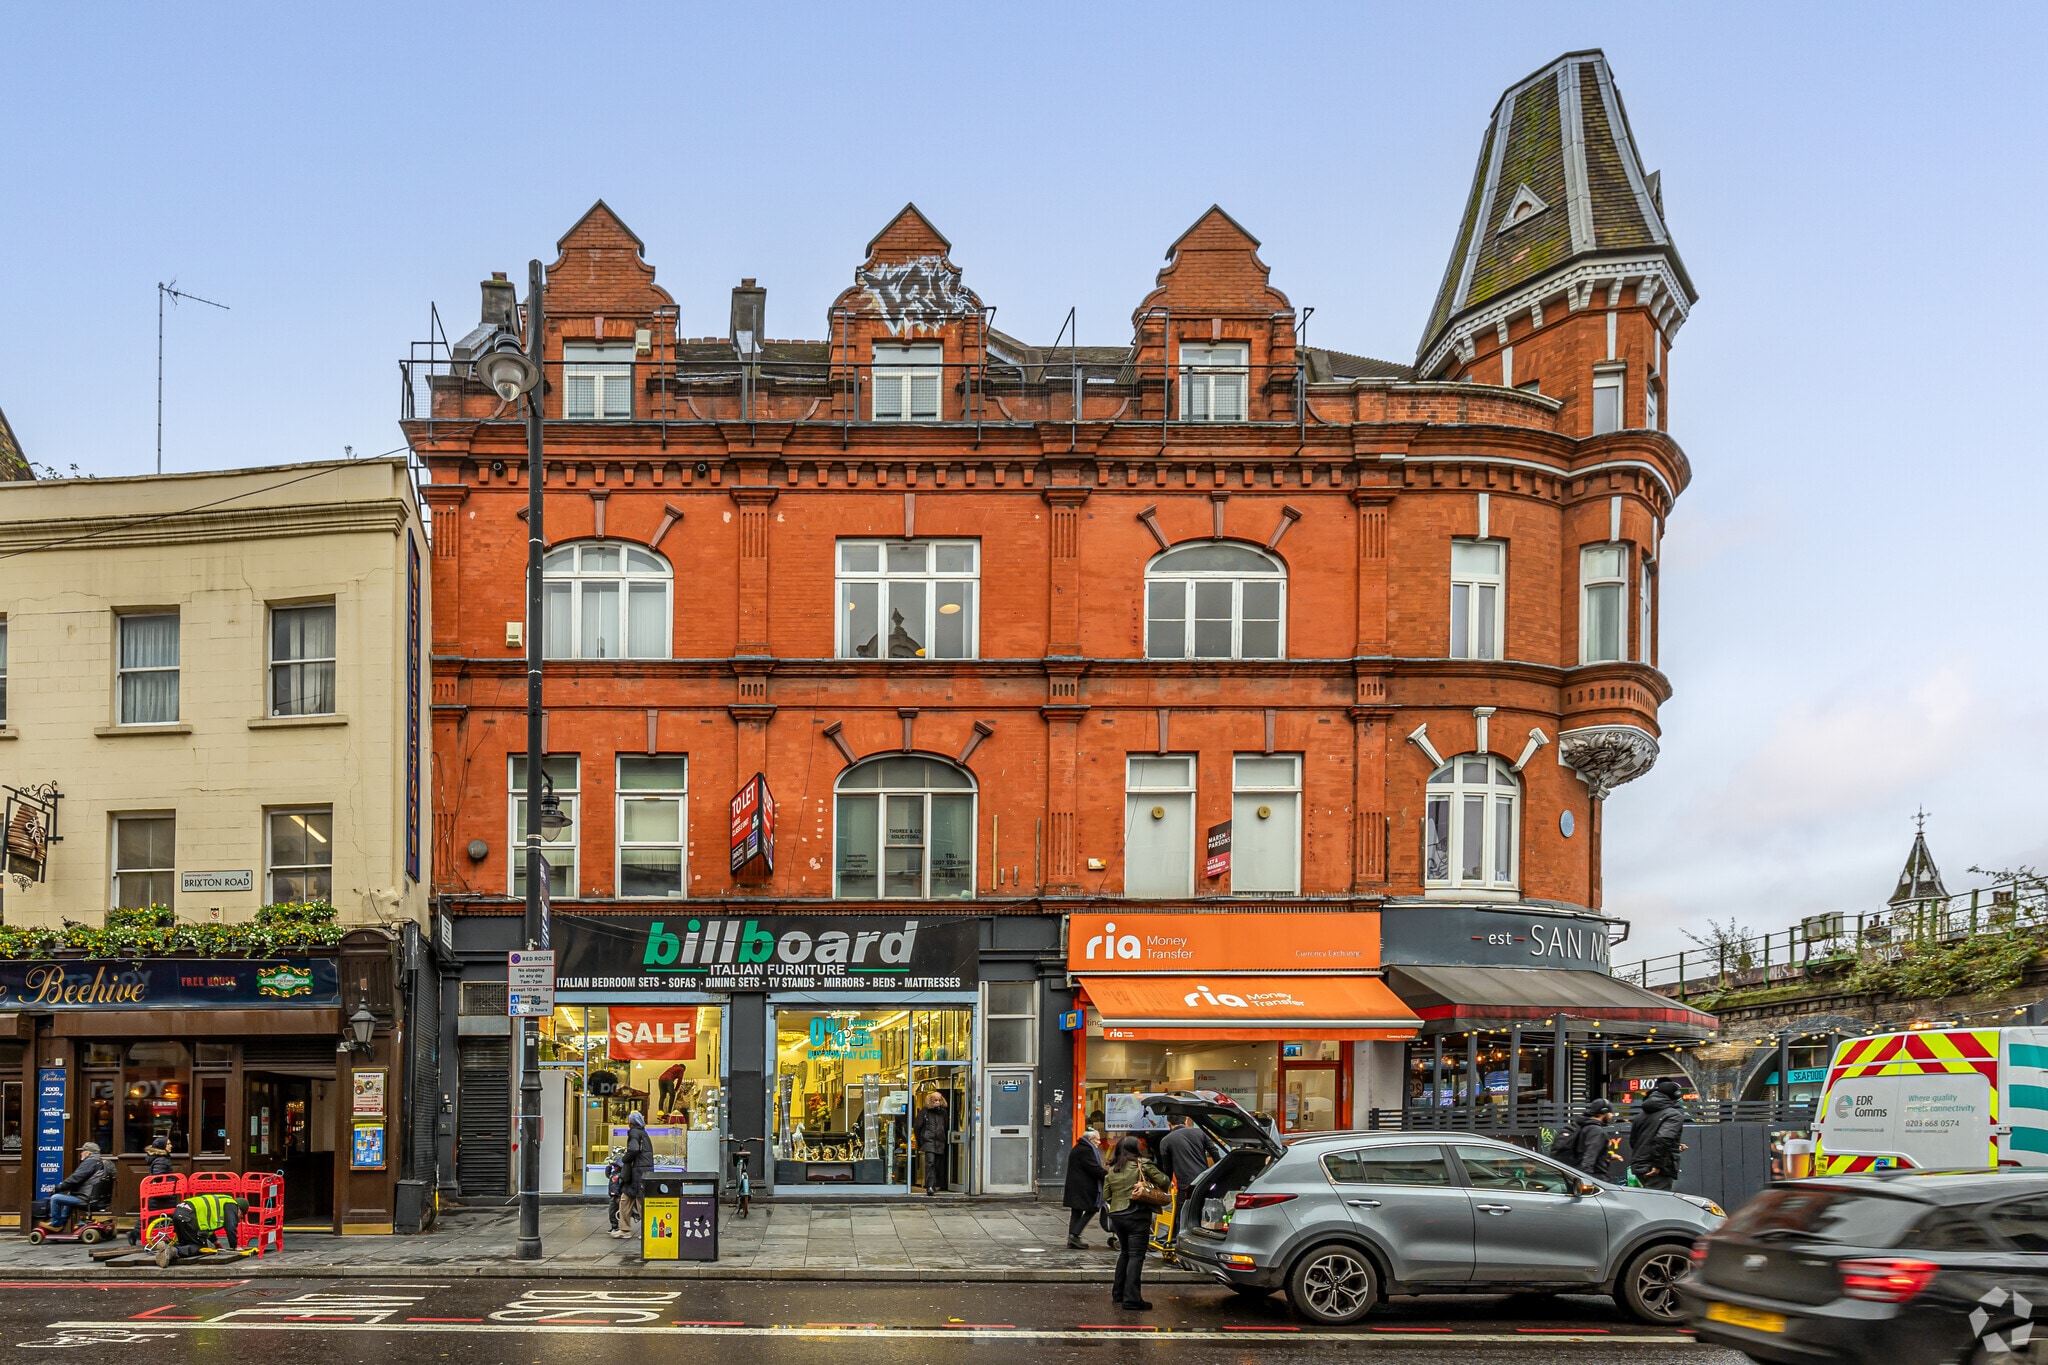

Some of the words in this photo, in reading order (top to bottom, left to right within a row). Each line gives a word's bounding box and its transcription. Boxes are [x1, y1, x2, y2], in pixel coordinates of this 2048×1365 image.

[732, 796, 742, 818] TO
[742, 782, 755, 810] LET
[1208, 836, 1231, 849] PARSONS
[1209, 832, 1226, 843] MARSH
[184, 878, 222, 888] BRIXTON
[224, 877, 250, 887] ROAD
[643, 919, 919, 965] billboard
[1086, 922, 1142, 960] ria
[1146, 935, 1188, 948] Money
[1488, 931, 1512, 945] est
[1530, 924, 1582, 960] SAN
[1146, 948, 1194, 959] Transfer
[1295, 949, 1326, 958] Currency
[1328, 949, 1362, 958] Exchange
[710, 964, 763, 976] ITALIAN
[767, 964, 845, 976] FURNITURE
[17, 964, 145, 1004] Beehive
[181, 976, 204, 987] FREE
[207, 975, 236, 987] HOUSE
[556, 977, 590, 988] ITALIAN
[591, 977, 636, 988] BEDROOM
[638, 977, 660, 988] SETS
[668, 977, 697, 988] SOFAS
[705, 977, 736, 988] DINING
[738, 977, 760, 988] SETS
[768, 977, 780, 988] TV
[781, 977, 815, 988] STANDS
[824, 977, 865, 988] MIRRORS
[872, 977, 896, 988] BEDS
[904, 977, 961, 988] MATTRESSES
[1184, 985, 1249, 1008] ria
[1246, 991, 1292, 1001] Money
[1251, 999, 1305, 1008] Transfer
[615, 1021, 691, 1044] SALE
[809, 1016, 846, 1047] 0%
[1109, 1028, 1123, 1037] ria
[843, 1050, 858, 1060] PAY
[859, 1050, 882, 1060] LATER
[1794, 1070, 1824, 1081] SEAFOOD
[1221, 1086, 1248, 1094] Matters
[1856, 1095, 1874, 1106] EDR
[1908, 1094, 1931, 1102] Where
[1932, 1094, 1958, 1103] quality
[1854, 1107, 1888, 1118] Comms
[1906, 1105, 1928, 1113] meets
[1930, 1104, 1977, 1113] connectivity
[1905, 1119, 1923, 1128] 0203
[1925, 1119, 1939, 1127] 668
[1940, 1119, 1960, 1128] 0574
[488, 1290, 682, 1323] BUS
